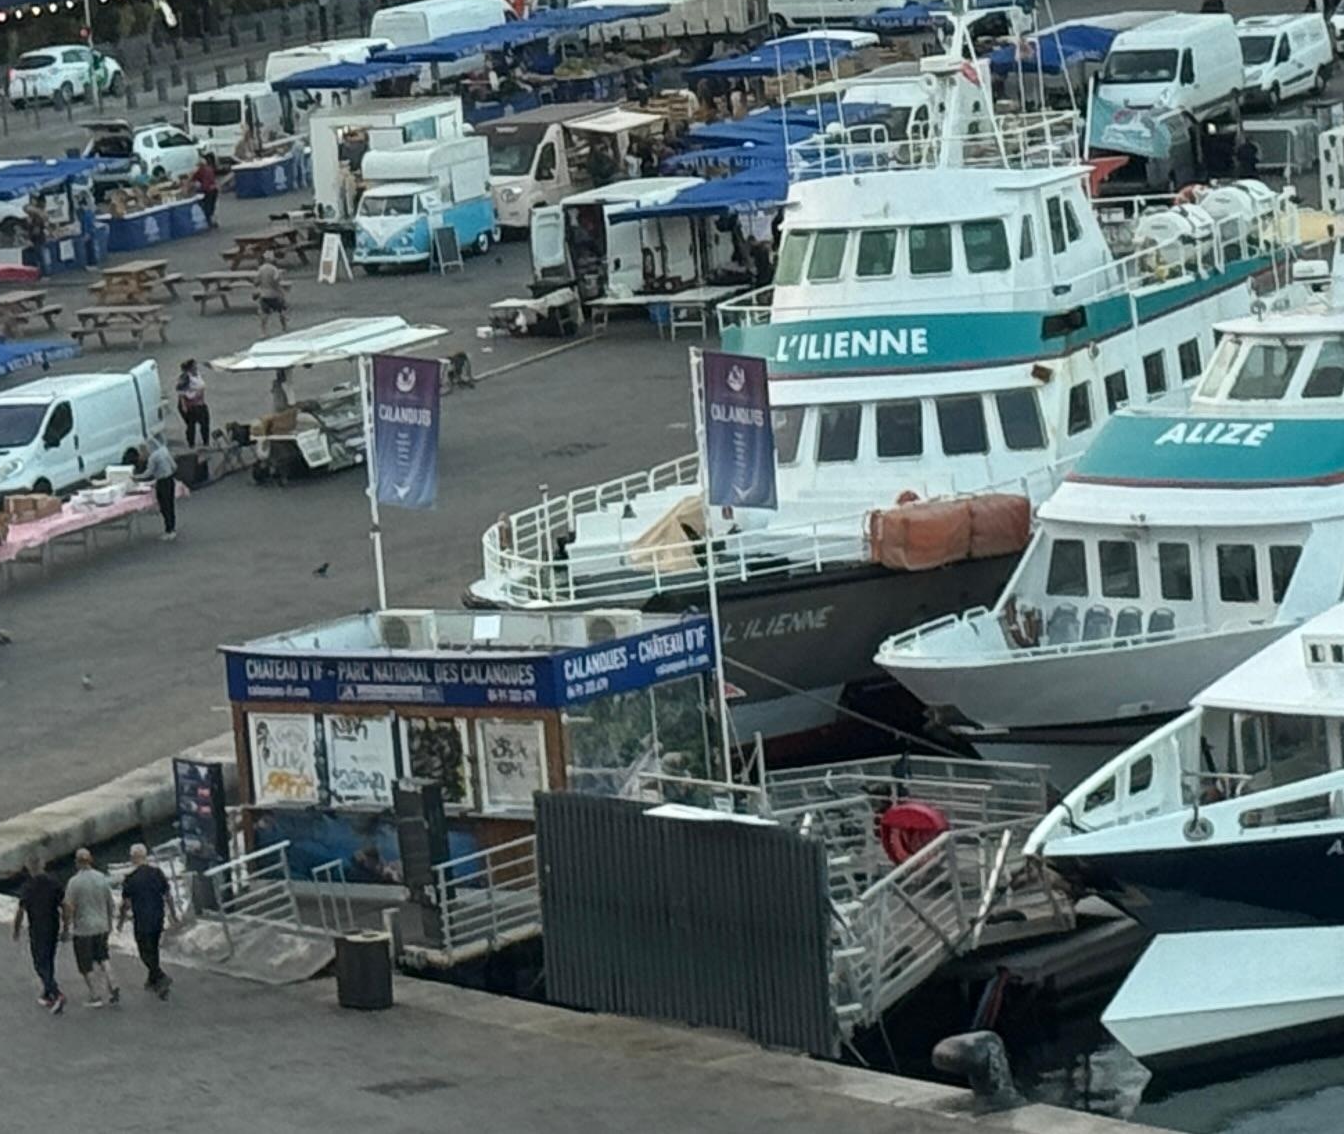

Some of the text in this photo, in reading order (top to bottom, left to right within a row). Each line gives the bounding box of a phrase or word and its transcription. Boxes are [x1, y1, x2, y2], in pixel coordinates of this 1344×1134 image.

[776, 328, 928, 362] L'ILIENNE
[722, 605, 835, 643] L'ILIENNE
[337, 661, 370, 682] PARC
[373, 662, 431, 683] NATIONAL
[434, 664, 458, 684] DES
[460, 664, 536, 685] CALANQUES
[564, 646, 629, 681] CALANQUES
